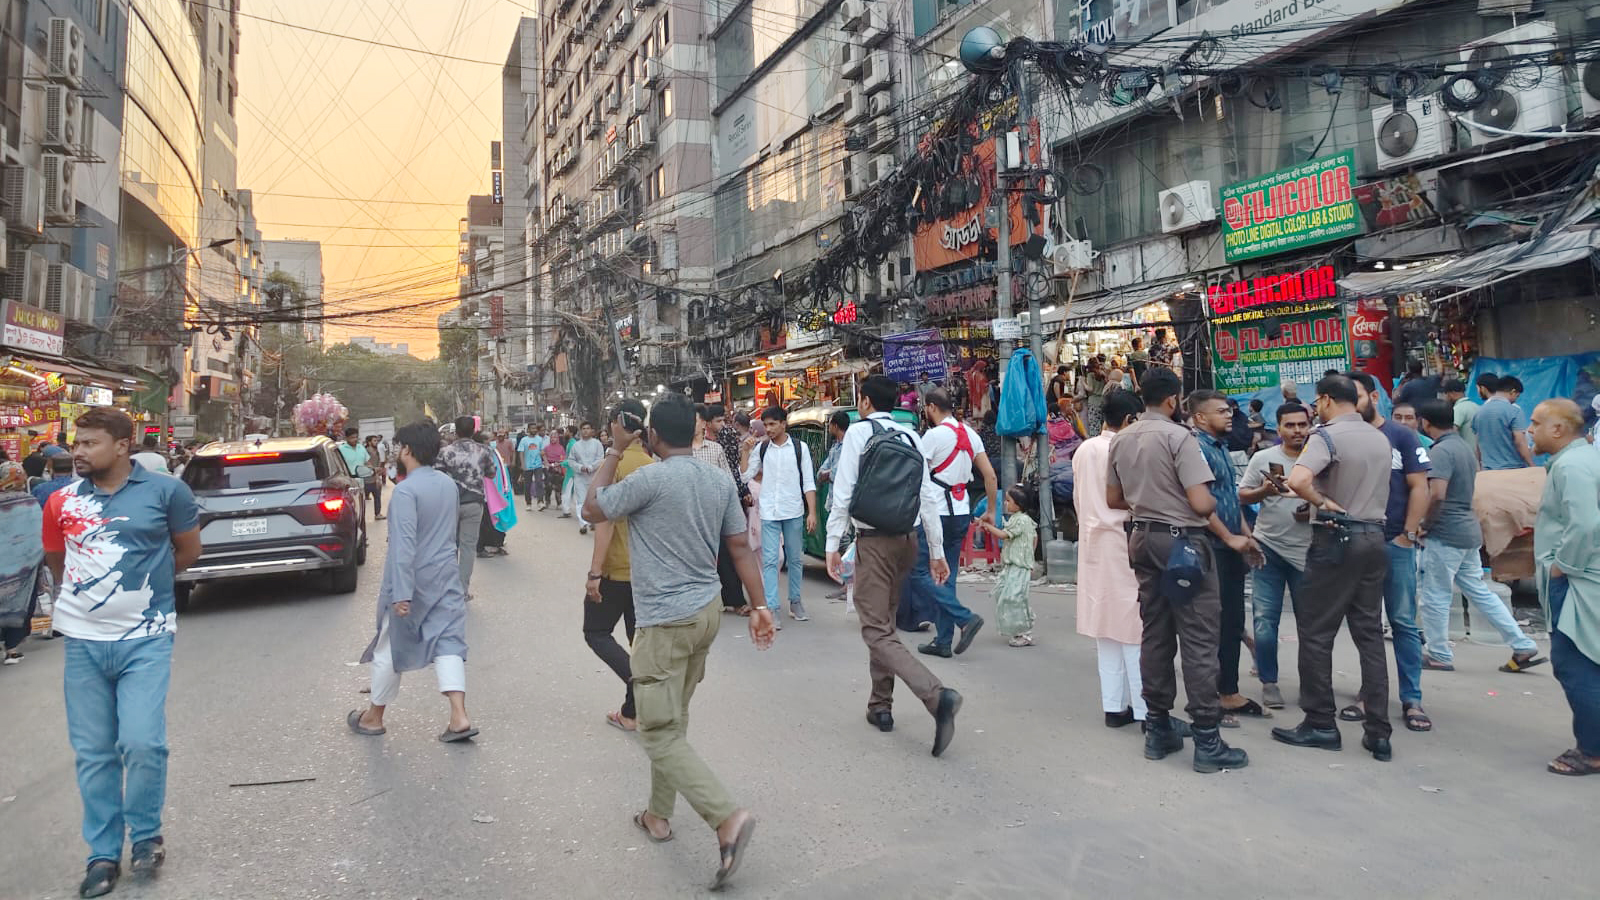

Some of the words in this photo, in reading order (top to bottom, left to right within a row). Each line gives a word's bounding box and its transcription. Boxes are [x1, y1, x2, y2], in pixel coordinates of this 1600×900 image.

[1231, 0, 1298, 41] Standard
[1242, 165, 1352, 227] FUJICOLOR
[1226, 230, 1246, 248] PHOTO
[1246, 226, 1260, 243] LINE
[1260, 220, 1284, 241] DIGITAL
[1284, 214, 1308, 235] COLOR
[1308, 210, 1321, 228] LAB
[1322, 209, 1328, 225] &
[1329, 202, 1354, 224] STUDIO
[1226, 265, 1336, 312] FUJICOLOR
[13, 306, 35, 327] JUICE
[1241, 352, 1255, 362] PHOTO
[1255, 351, 1268, 361] LINE
[1269, 349, 1288, 360] DIGITAL
[1288, 347, 1307, 358] COLOR
[1307, 346, 1317, 356] LAB
[1324, 344, 1344, 355] STUDIO
[1415, 447, 1431, 464] 2
